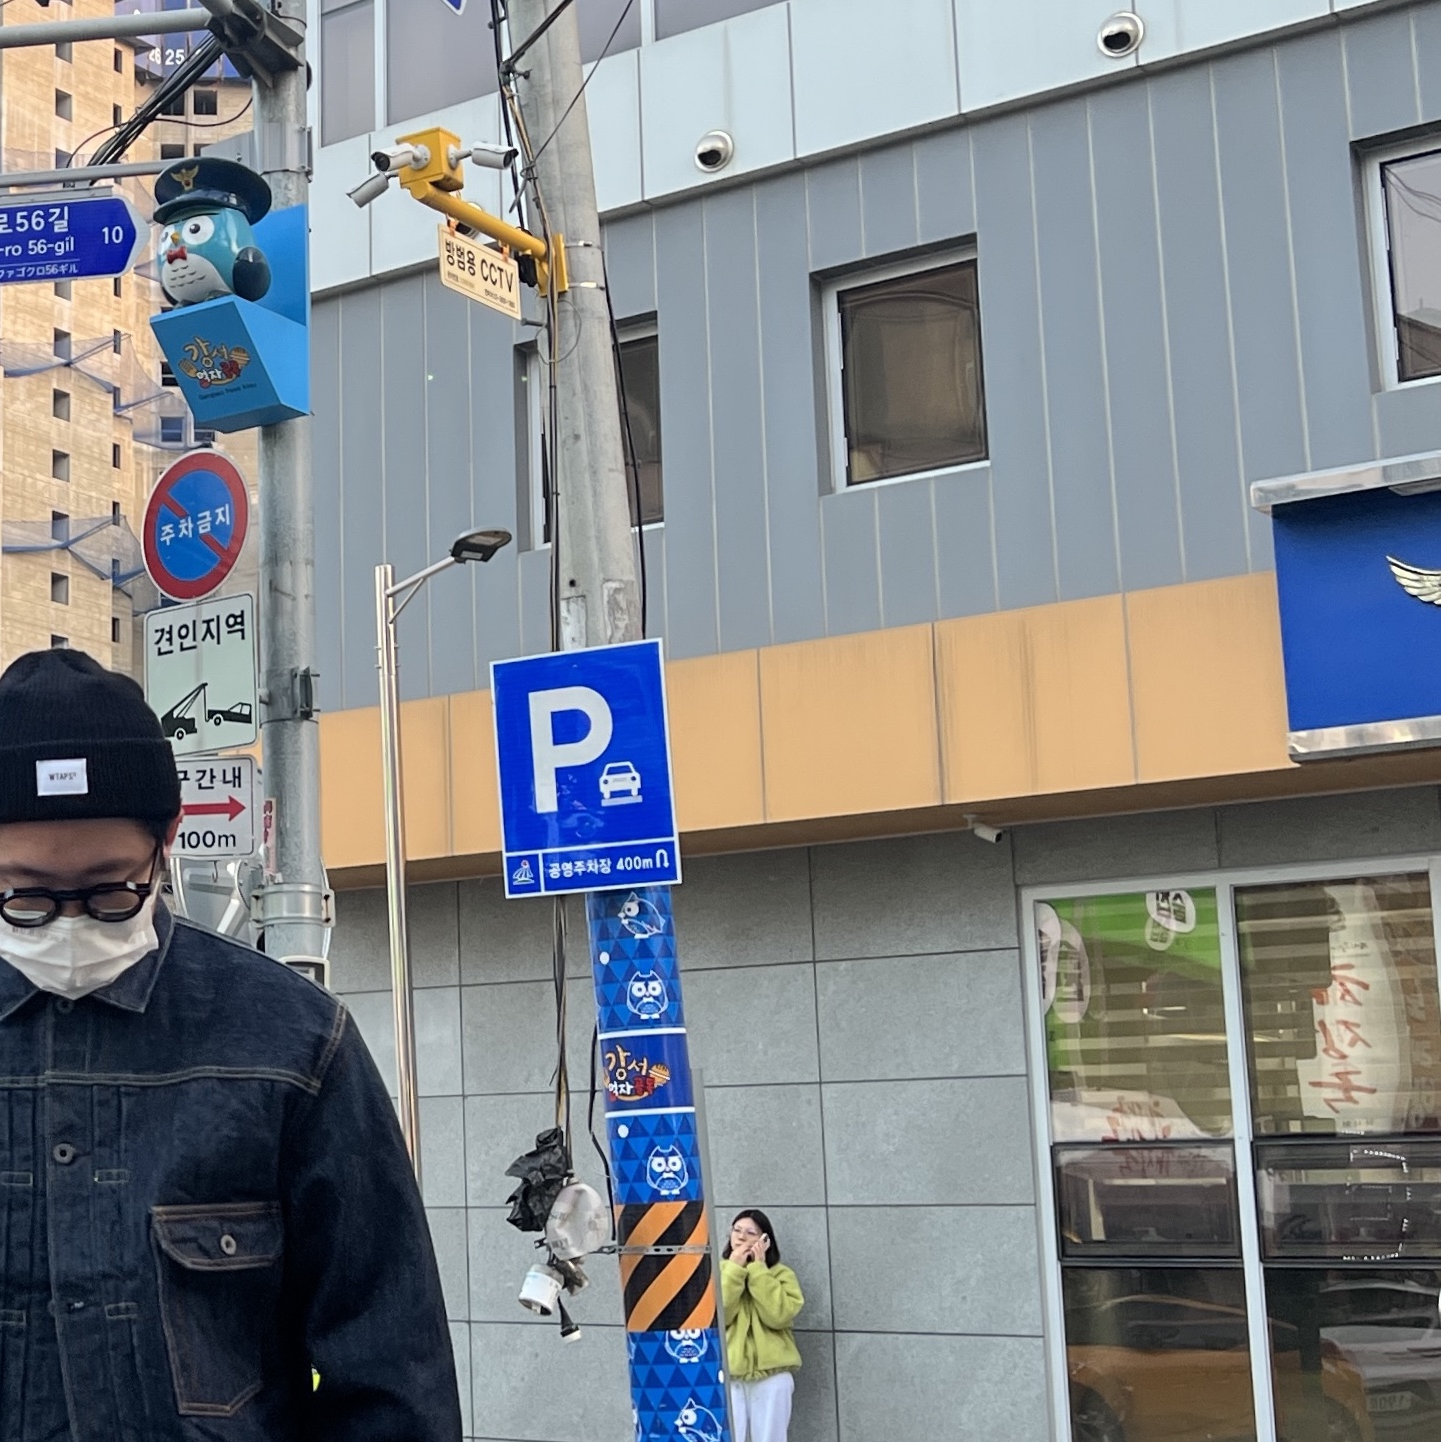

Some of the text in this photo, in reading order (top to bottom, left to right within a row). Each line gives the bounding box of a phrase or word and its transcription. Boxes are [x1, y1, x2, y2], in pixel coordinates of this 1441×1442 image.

[165, 49, 185, 65] 25
[27, 236, 75, 256] 56-gil
[101, 226, 123, 245] 10
[445, 238, 514, 293] 방범용 CCTV
[184, 336, 228, 368] 강서
[160, 503, 230, 546] 주차금지
[154, 610, 245, 656] 견인지역
[528, 685, 613, 814] P
[178, 830, 236, 849] 100m
[549, 856, 653, 879] 공영주차장 400m
[605, 1044, 648, 1080] 강서
